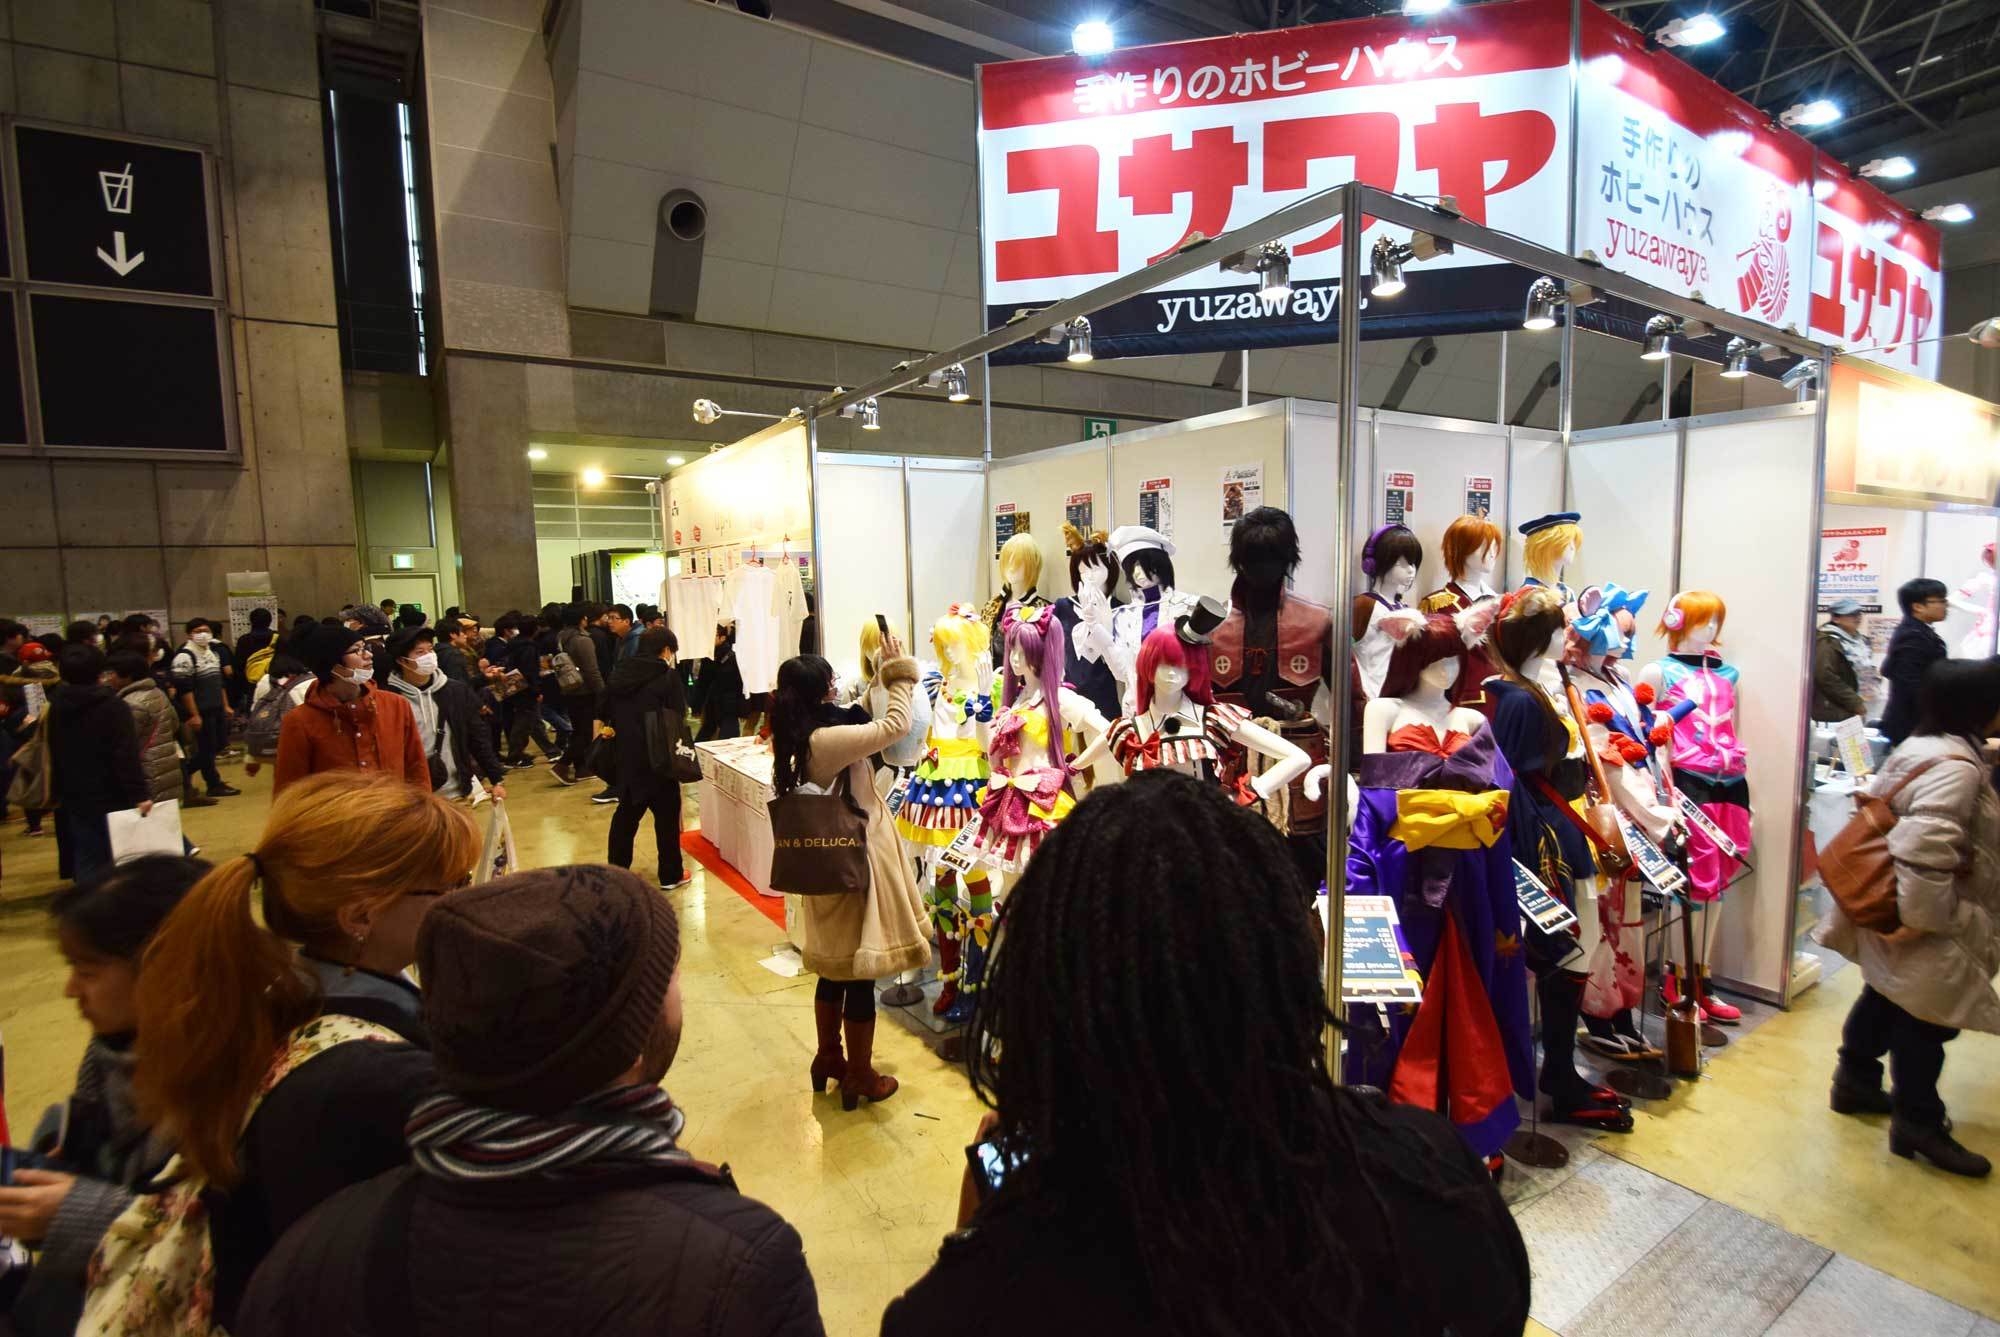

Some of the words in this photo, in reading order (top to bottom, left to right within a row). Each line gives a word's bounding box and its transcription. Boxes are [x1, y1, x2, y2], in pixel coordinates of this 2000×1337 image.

[1072, 34, 1463, 114] 手作りのホビーハス
[1156, 284, 1368, 333] yuzaway
[1830, 573, 1879, 582] Twitter
